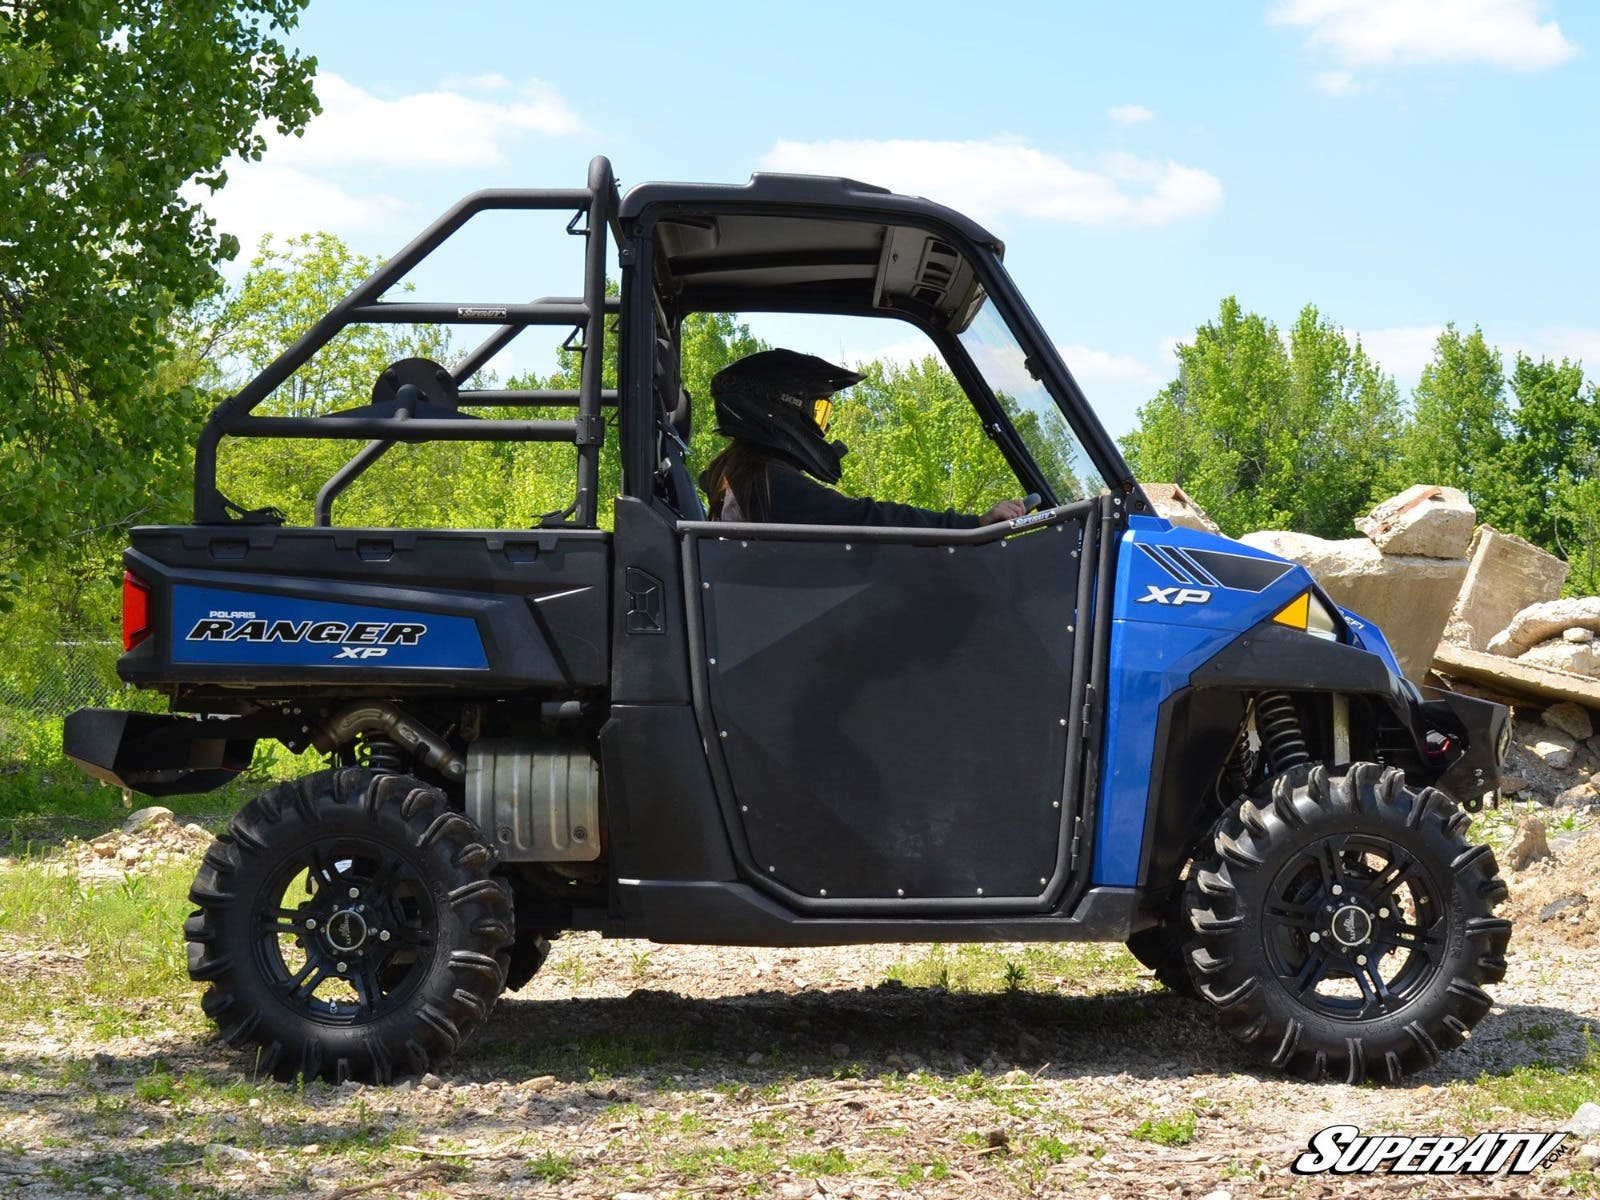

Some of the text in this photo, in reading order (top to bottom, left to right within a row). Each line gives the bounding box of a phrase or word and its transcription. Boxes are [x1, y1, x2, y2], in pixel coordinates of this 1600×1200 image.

[1135, 585, 1211, 605] XP
[209, 610, 256, 619] POLARIS
[185, 619, 427, 645] RANGER
[332, 646, 389, 659] XP
